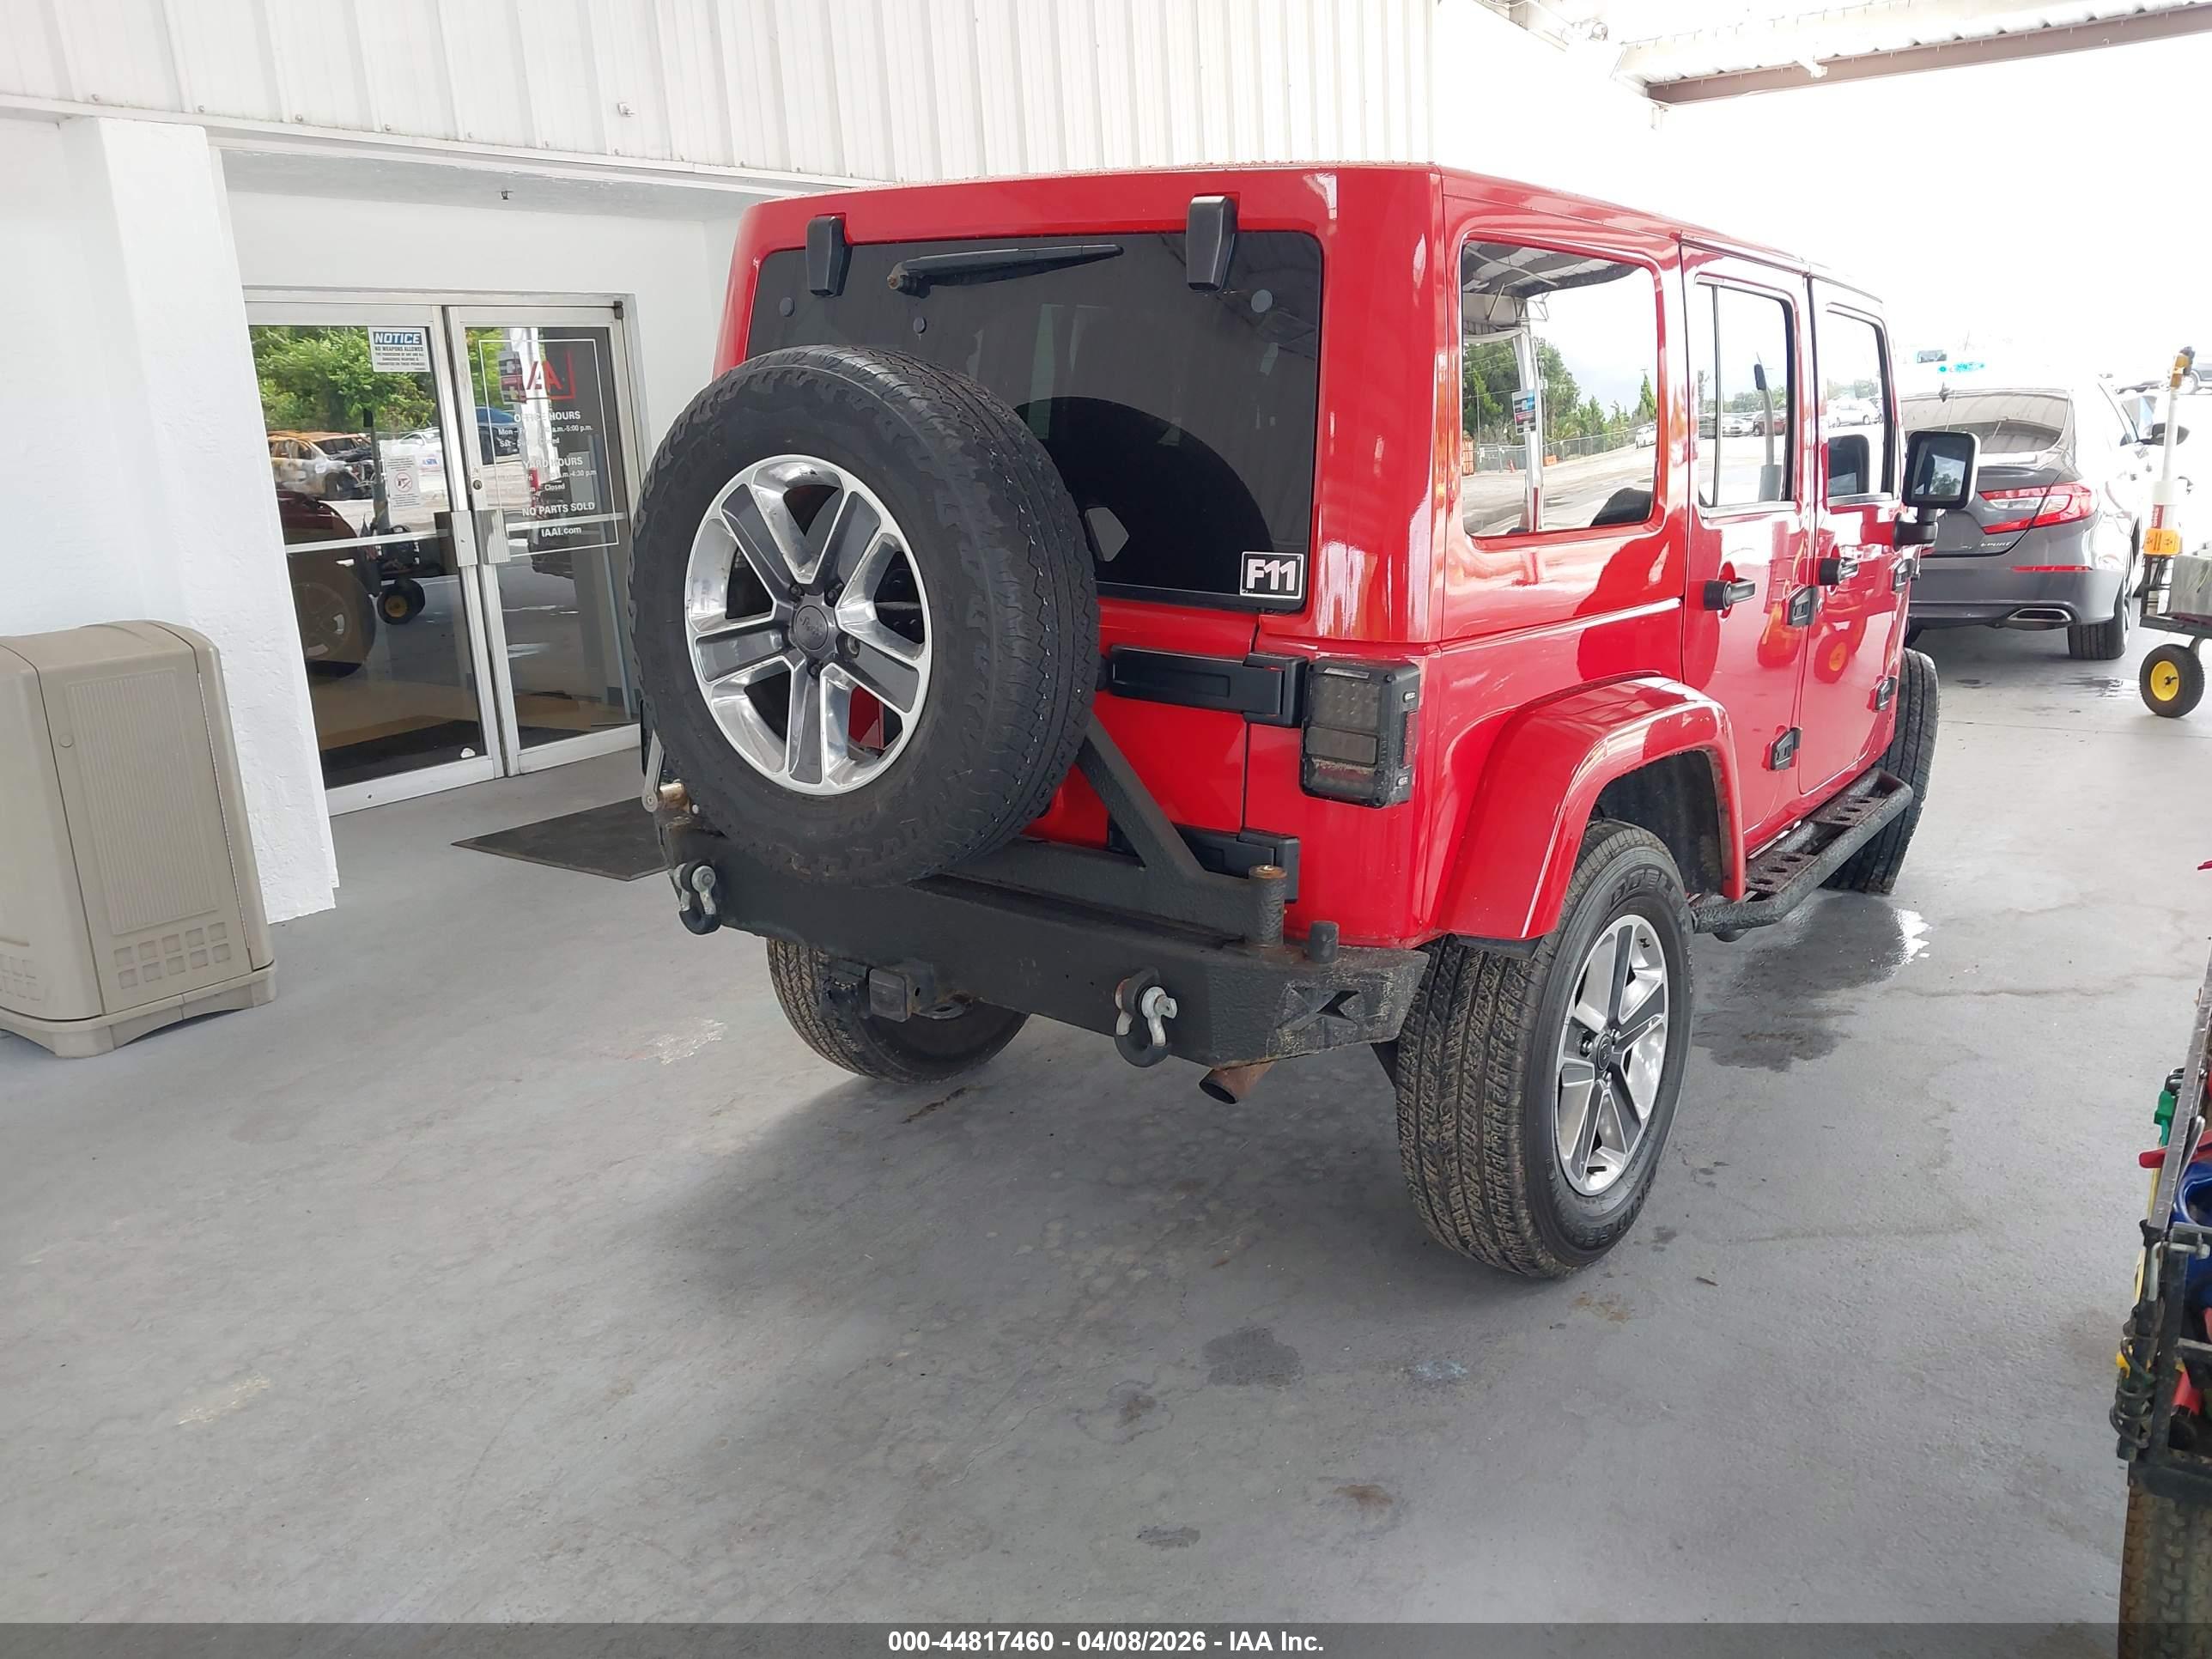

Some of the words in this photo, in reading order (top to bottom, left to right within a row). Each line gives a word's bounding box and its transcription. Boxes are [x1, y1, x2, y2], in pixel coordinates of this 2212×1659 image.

[375, 332, 421, 344] NOTICE
[550, 410, 580, 420] HOURS
[500, 439, 512, 447] Sat
[544, 483, 566, 491] Closed
[522, 507, 536, 517] NO
[538, 504, 568, 514] PARTS
[570, 501, 595, 512] SOLD
[541, 526, 582, 538] IAAI.com
[1246, 558, 1297, 592] F11
